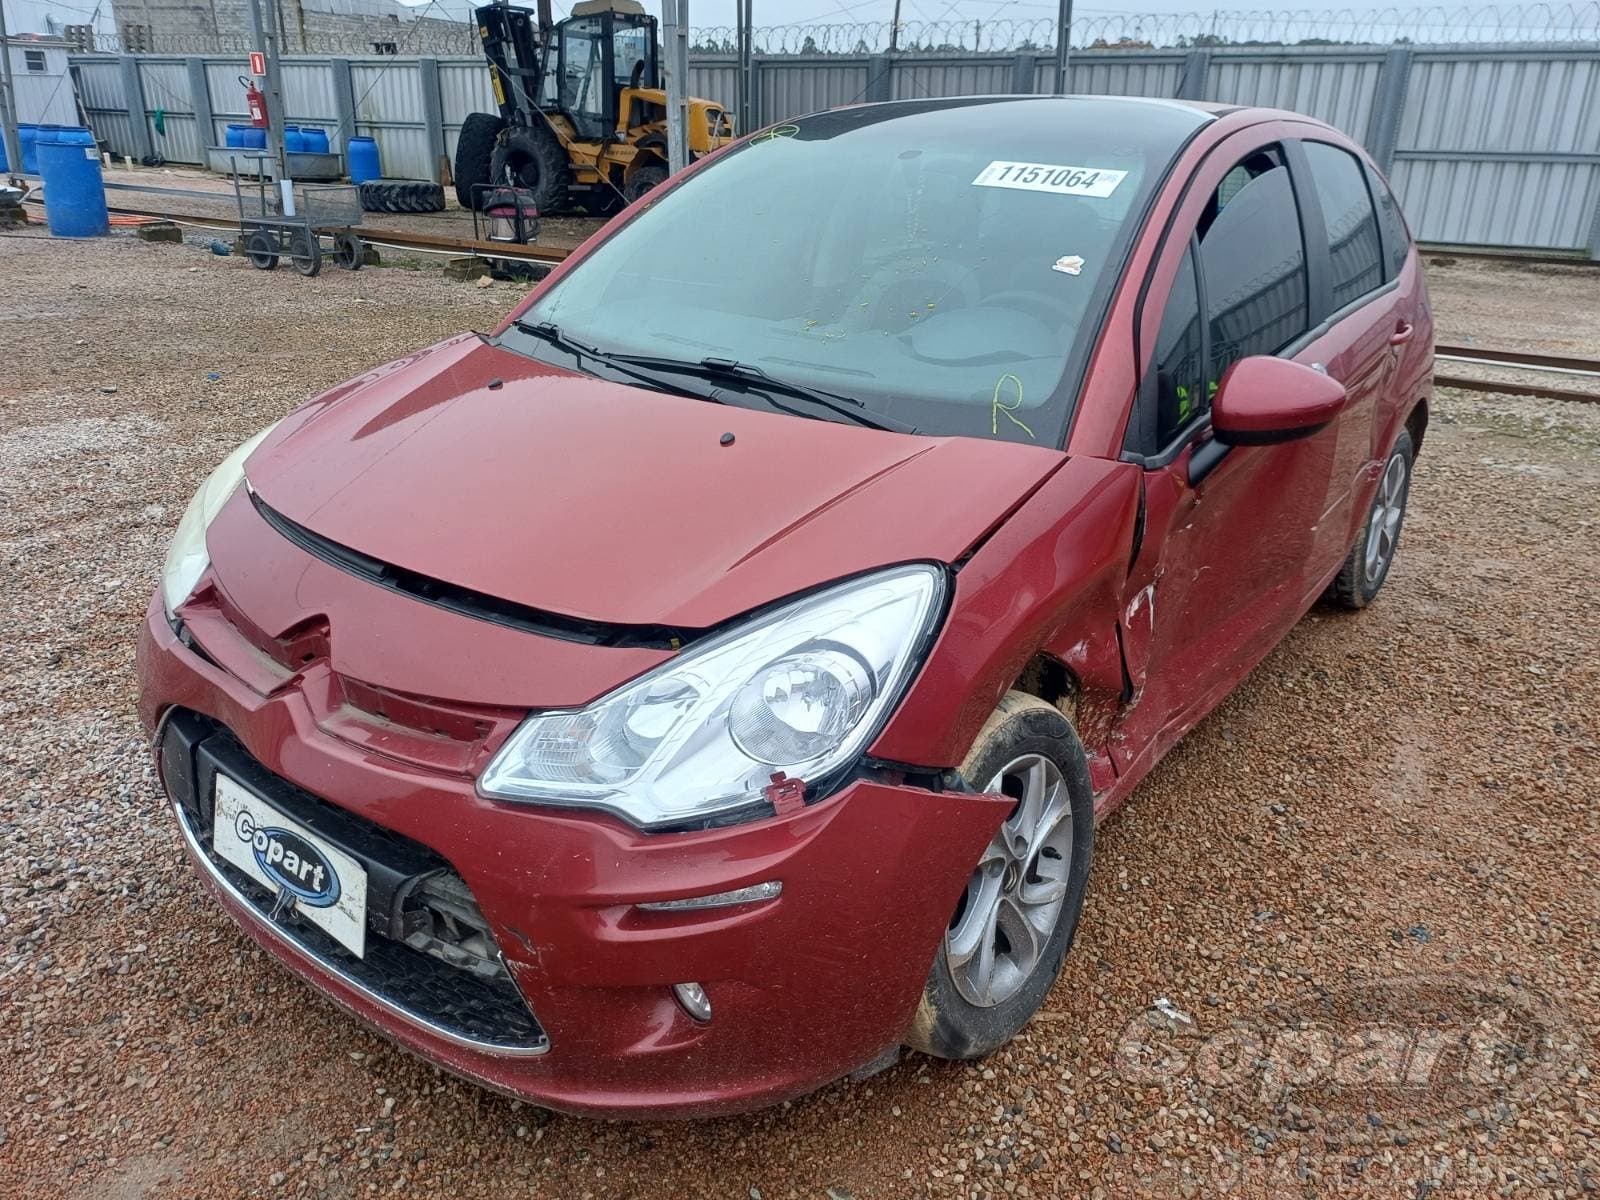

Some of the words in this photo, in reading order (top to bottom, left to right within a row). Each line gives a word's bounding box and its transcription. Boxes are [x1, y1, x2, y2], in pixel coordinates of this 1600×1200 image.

[998, 165, 1100, 188] 1151064
[993, 374, 1036, 439] R
[236, 811, 326, 892] Copart
